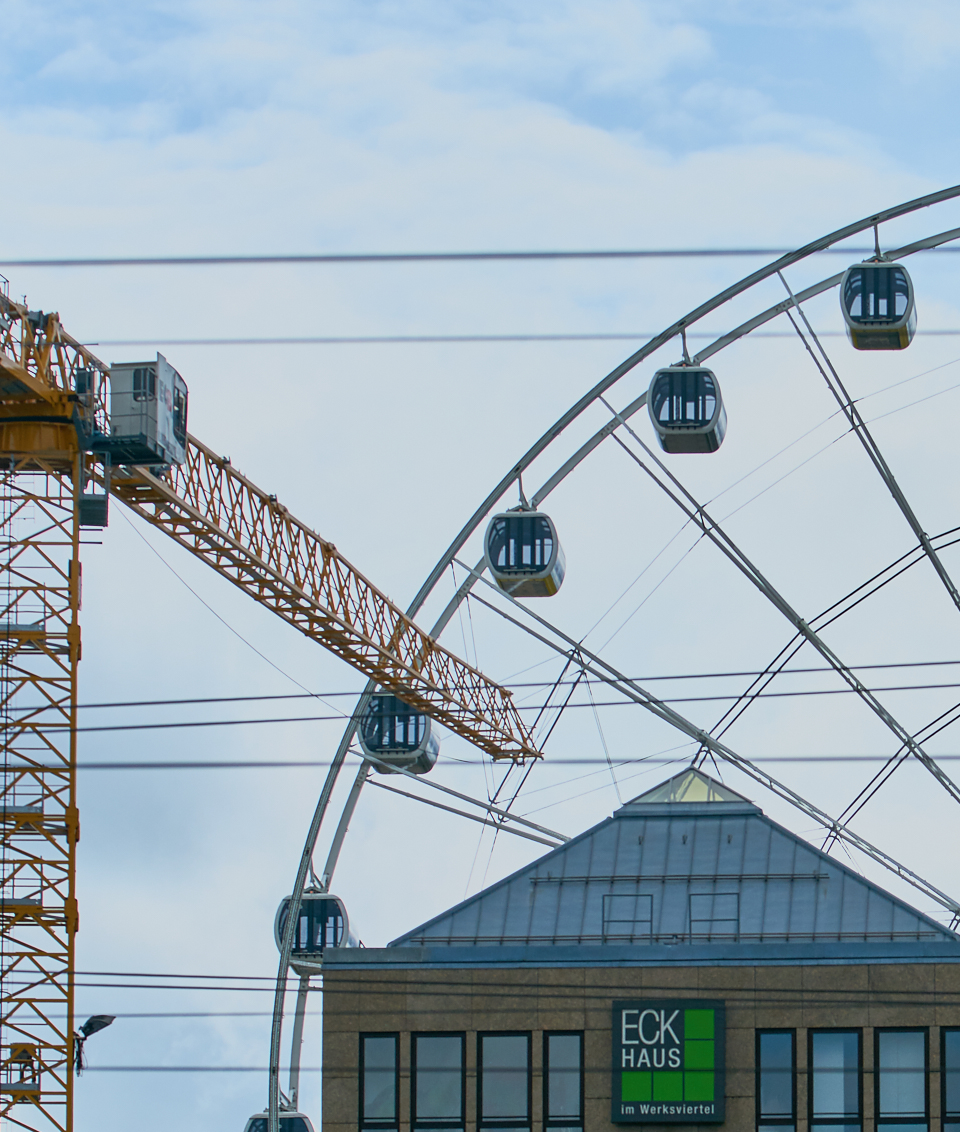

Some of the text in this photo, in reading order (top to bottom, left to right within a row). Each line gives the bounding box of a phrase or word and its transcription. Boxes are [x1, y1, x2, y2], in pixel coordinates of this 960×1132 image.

[621, 1009, 681, 1045] ECK
[621, 1048, 681, 1068] HAUS
[621, 1104, 715, 1115] im Werksviertel
